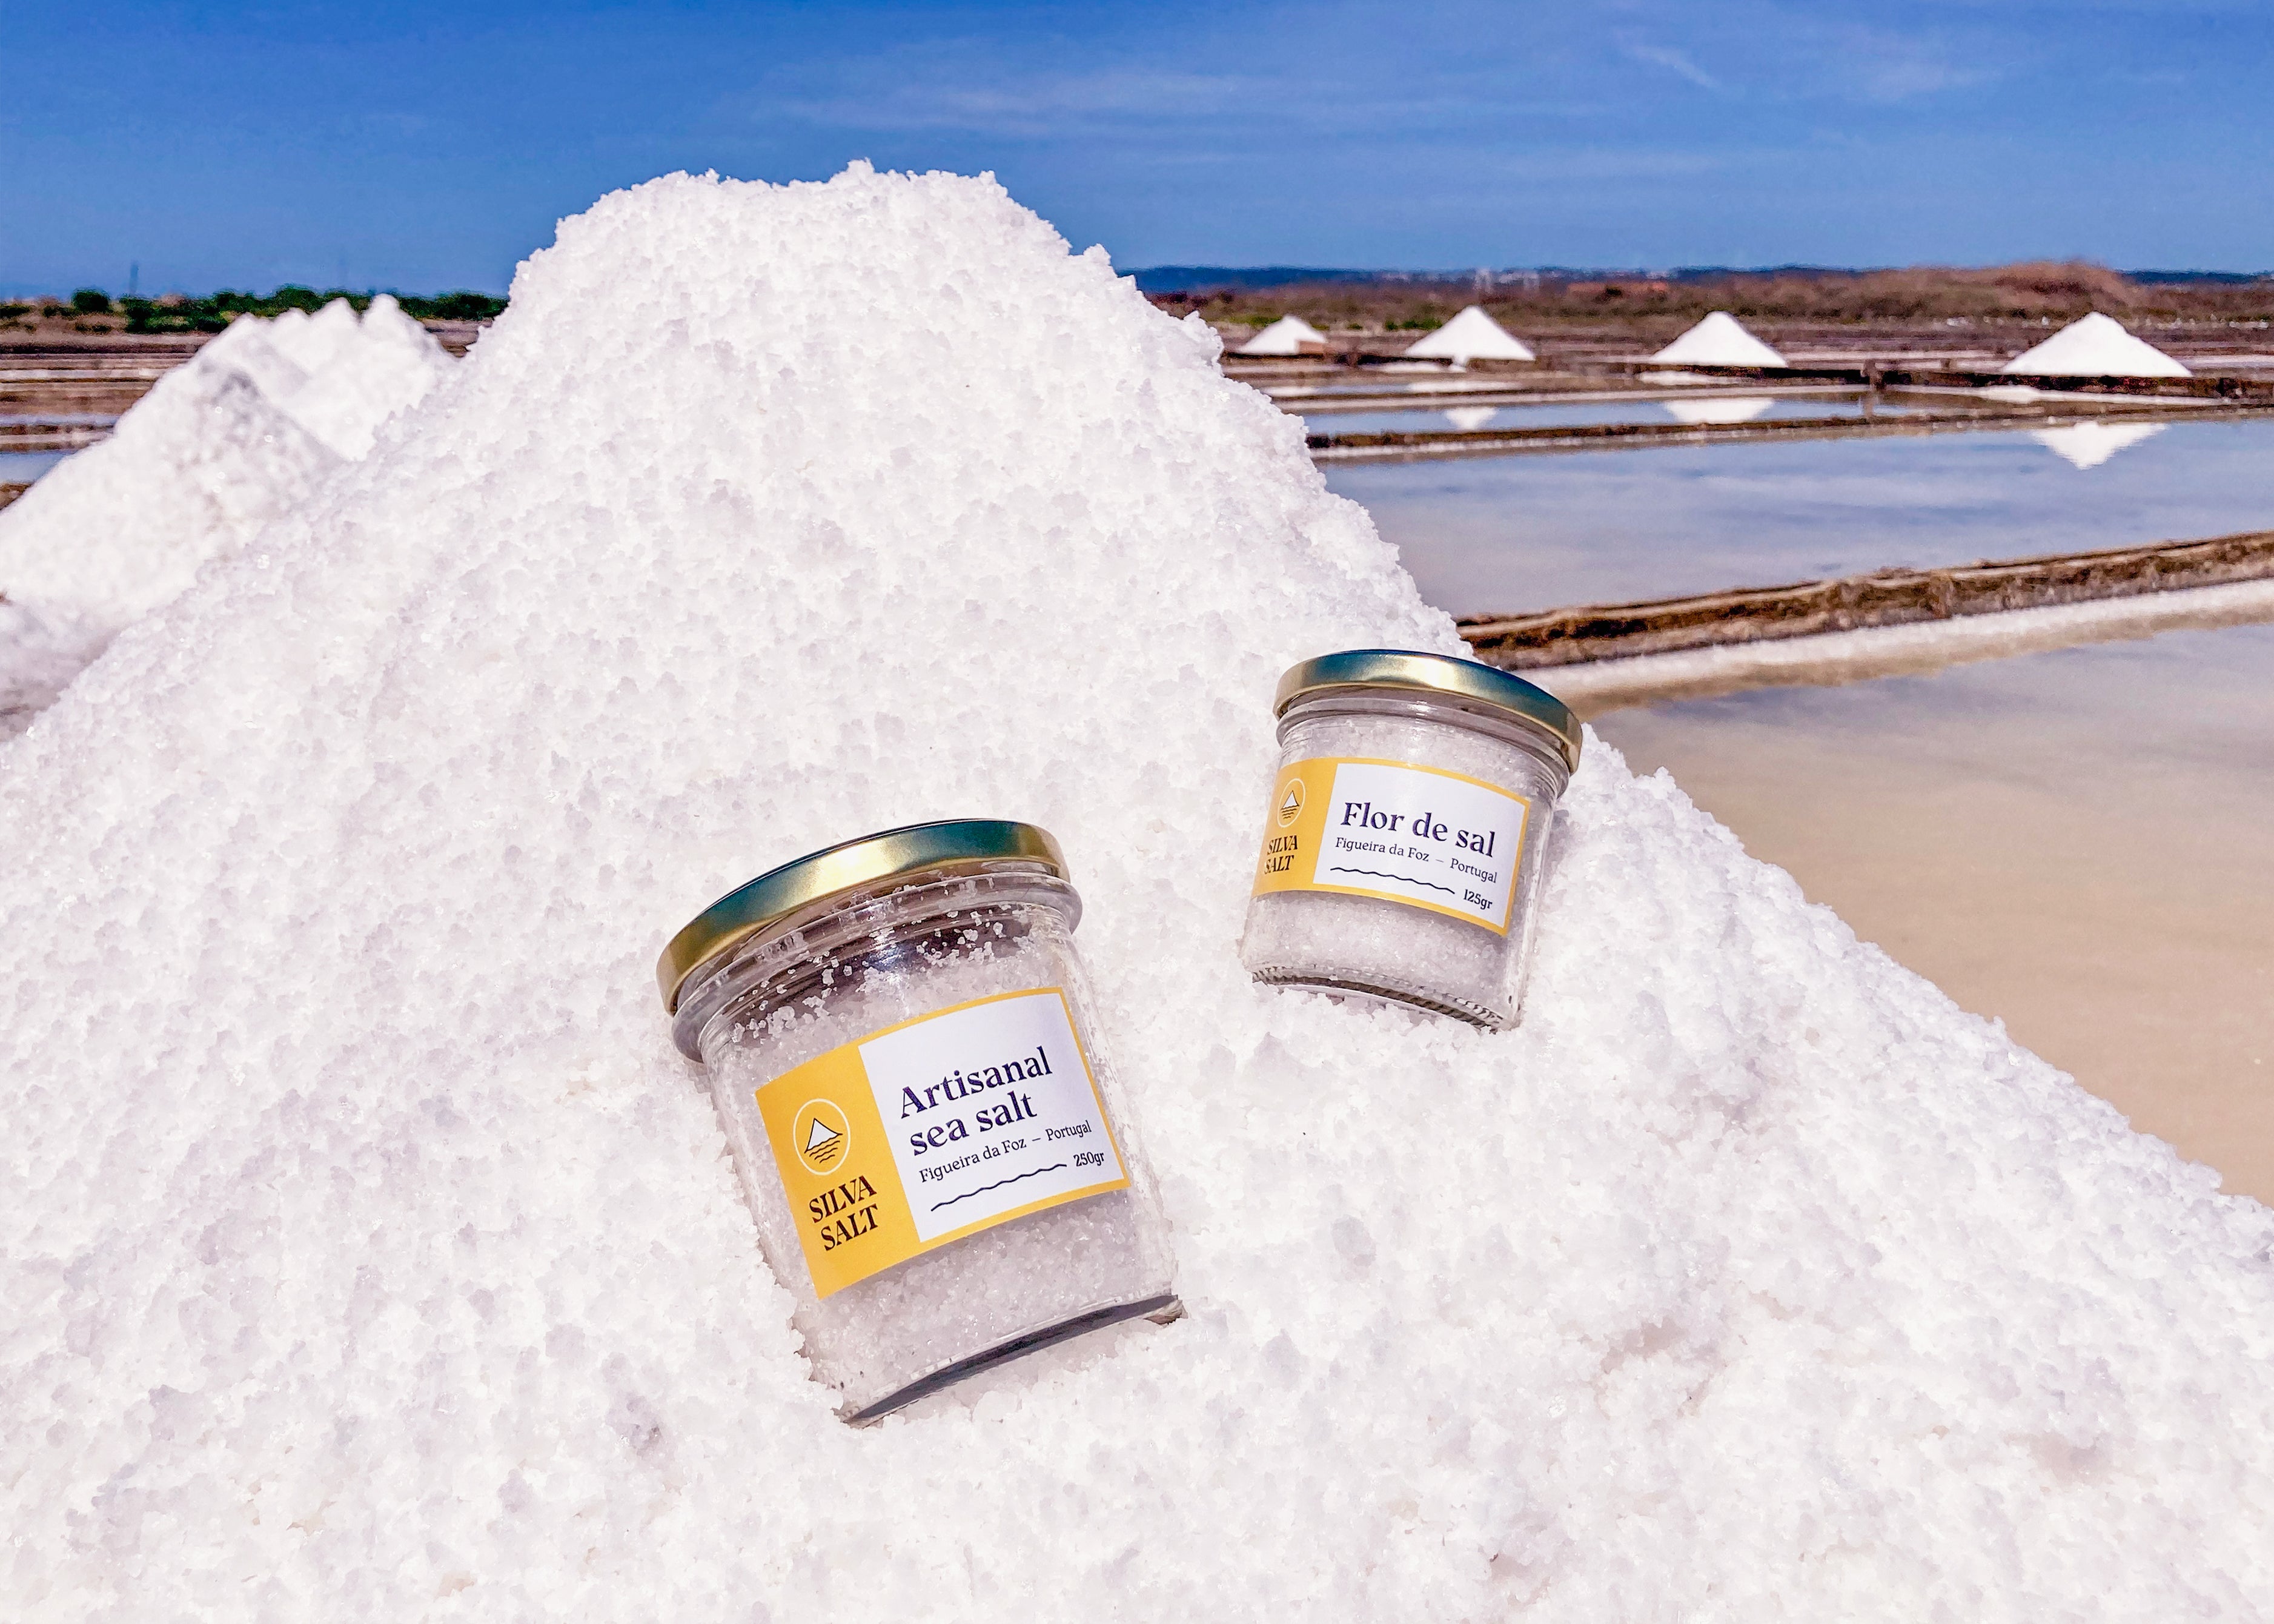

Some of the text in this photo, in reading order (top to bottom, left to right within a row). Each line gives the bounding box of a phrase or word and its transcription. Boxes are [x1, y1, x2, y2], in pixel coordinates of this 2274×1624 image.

[1267, 834, 1299, 856] SILVA
[1340, 801, 1496, 858] Flor de sal
[1263, 855, 1295, 875] SALT
[1334, 837, 1386, 854] Figueira
[1388, 843, 1405, 857] da
[1407, 847, 1430, 863] Foz
[1449, 858, 1497, 884] Portugal
[1462, 889, 1493, 910] 125gr
[900, 1046, 1053, 1119] Artisanal
[909, 1090, 1038, 1156] sea salt
[918, 1152, 981, 1184] Figueira
[982, 1144, 1001, 1161] da
[1003, 1137, 1027, 1155] Foz
[1044, 1119, 1092, 1143] Portugal
[1072, 1150, 1106, 1168] 250gr
[808, 1175, 878, 1224] SILVA
[820, 1204, 879, 1252] SALT
